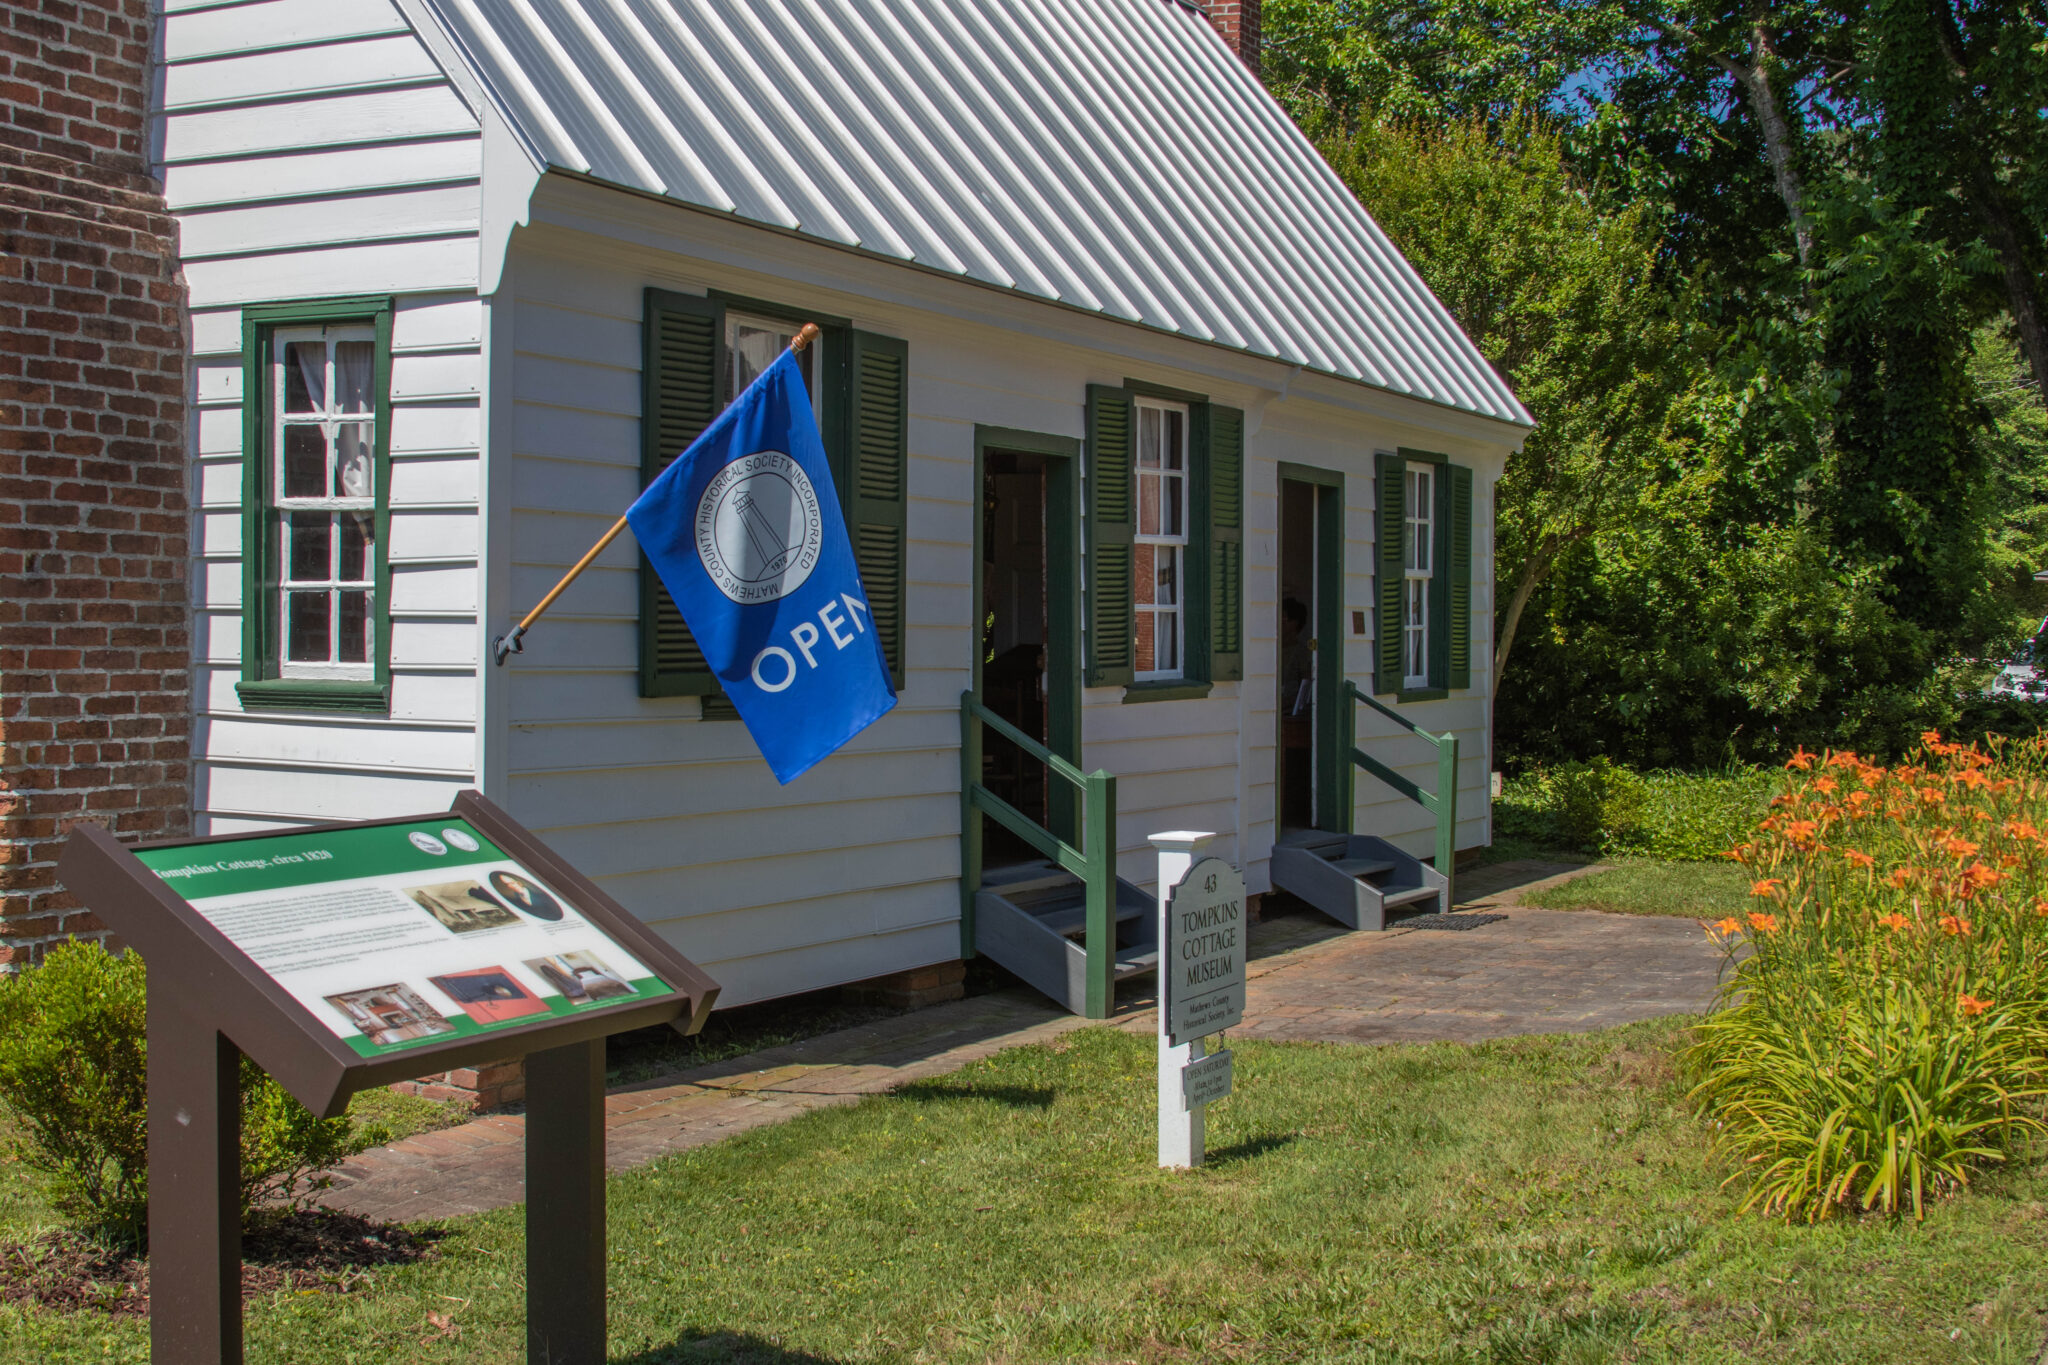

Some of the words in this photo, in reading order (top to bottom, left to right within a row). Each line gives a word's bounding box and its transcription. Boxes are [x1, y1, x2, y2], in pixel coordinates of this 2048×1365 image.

[746, 455, 793, 473] SOCIETY
[701, 465, 743, 524] HISTORICAL
[793, 468, 819, 570] INCORPORATED
[700, 528, 724, 578] COUNTY
[771, 556, 788, 571] 1970
[723, 577, 779, 599] MATHEWS
[152, 864, 218, 879] Tompkins
[216, 858, 273, 871] Cottage,
[272, 852, 304, 865] circa
[302, 849, 333, 862] 1820
[1204, 873, 1217, 894] 43
[1182, 900, 1238, 934] TOMPKINS
[1183, 927, 1236, 960] COTTAGE
[1186, 955, 1232, 987] MUSEUM
